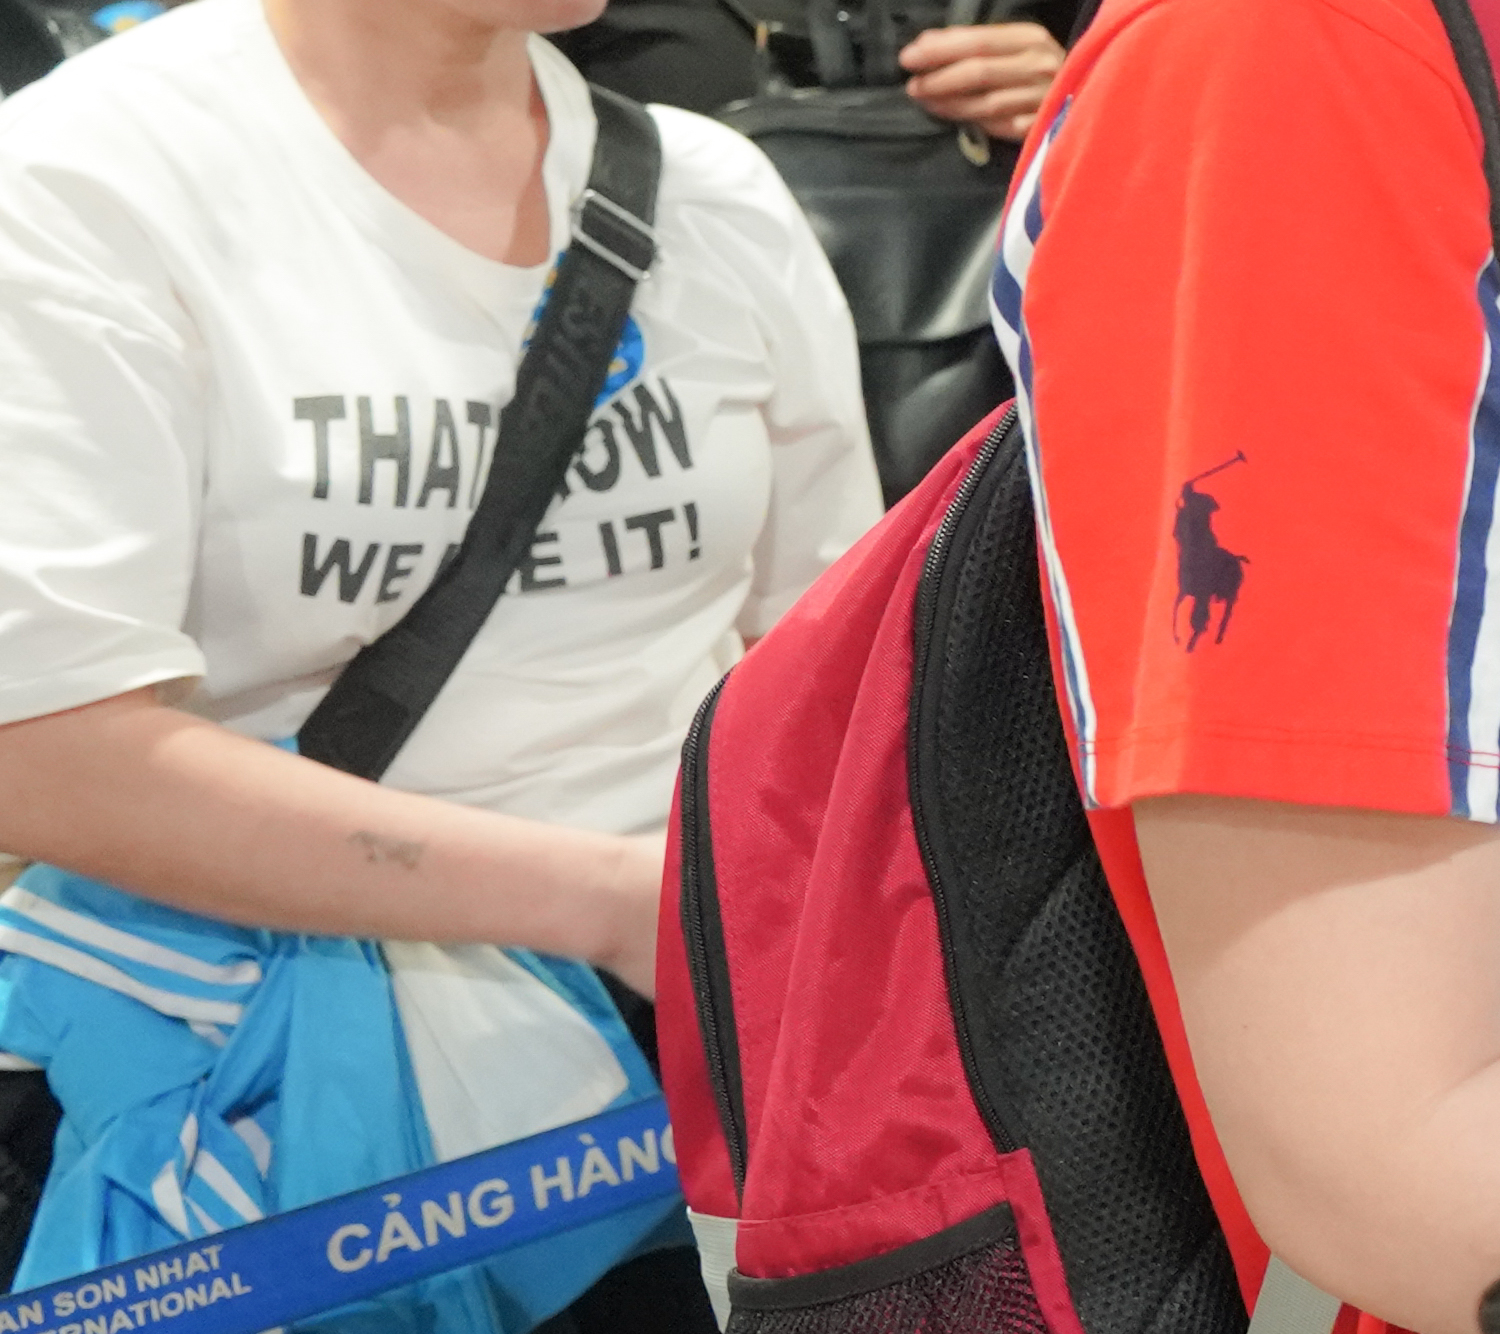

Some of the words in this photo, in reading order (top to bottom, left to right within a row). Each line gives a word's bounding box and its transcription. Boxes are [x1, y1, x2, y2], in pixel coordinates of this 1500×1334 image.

[301, 532, 424, 605] WE
[597, 501, 701, 578] IT!
[326, 1178, 515, 1274] CẢNG
[52, 1273, 128, 1318] SON
[134, 1243, 223, 1293] NHAT
